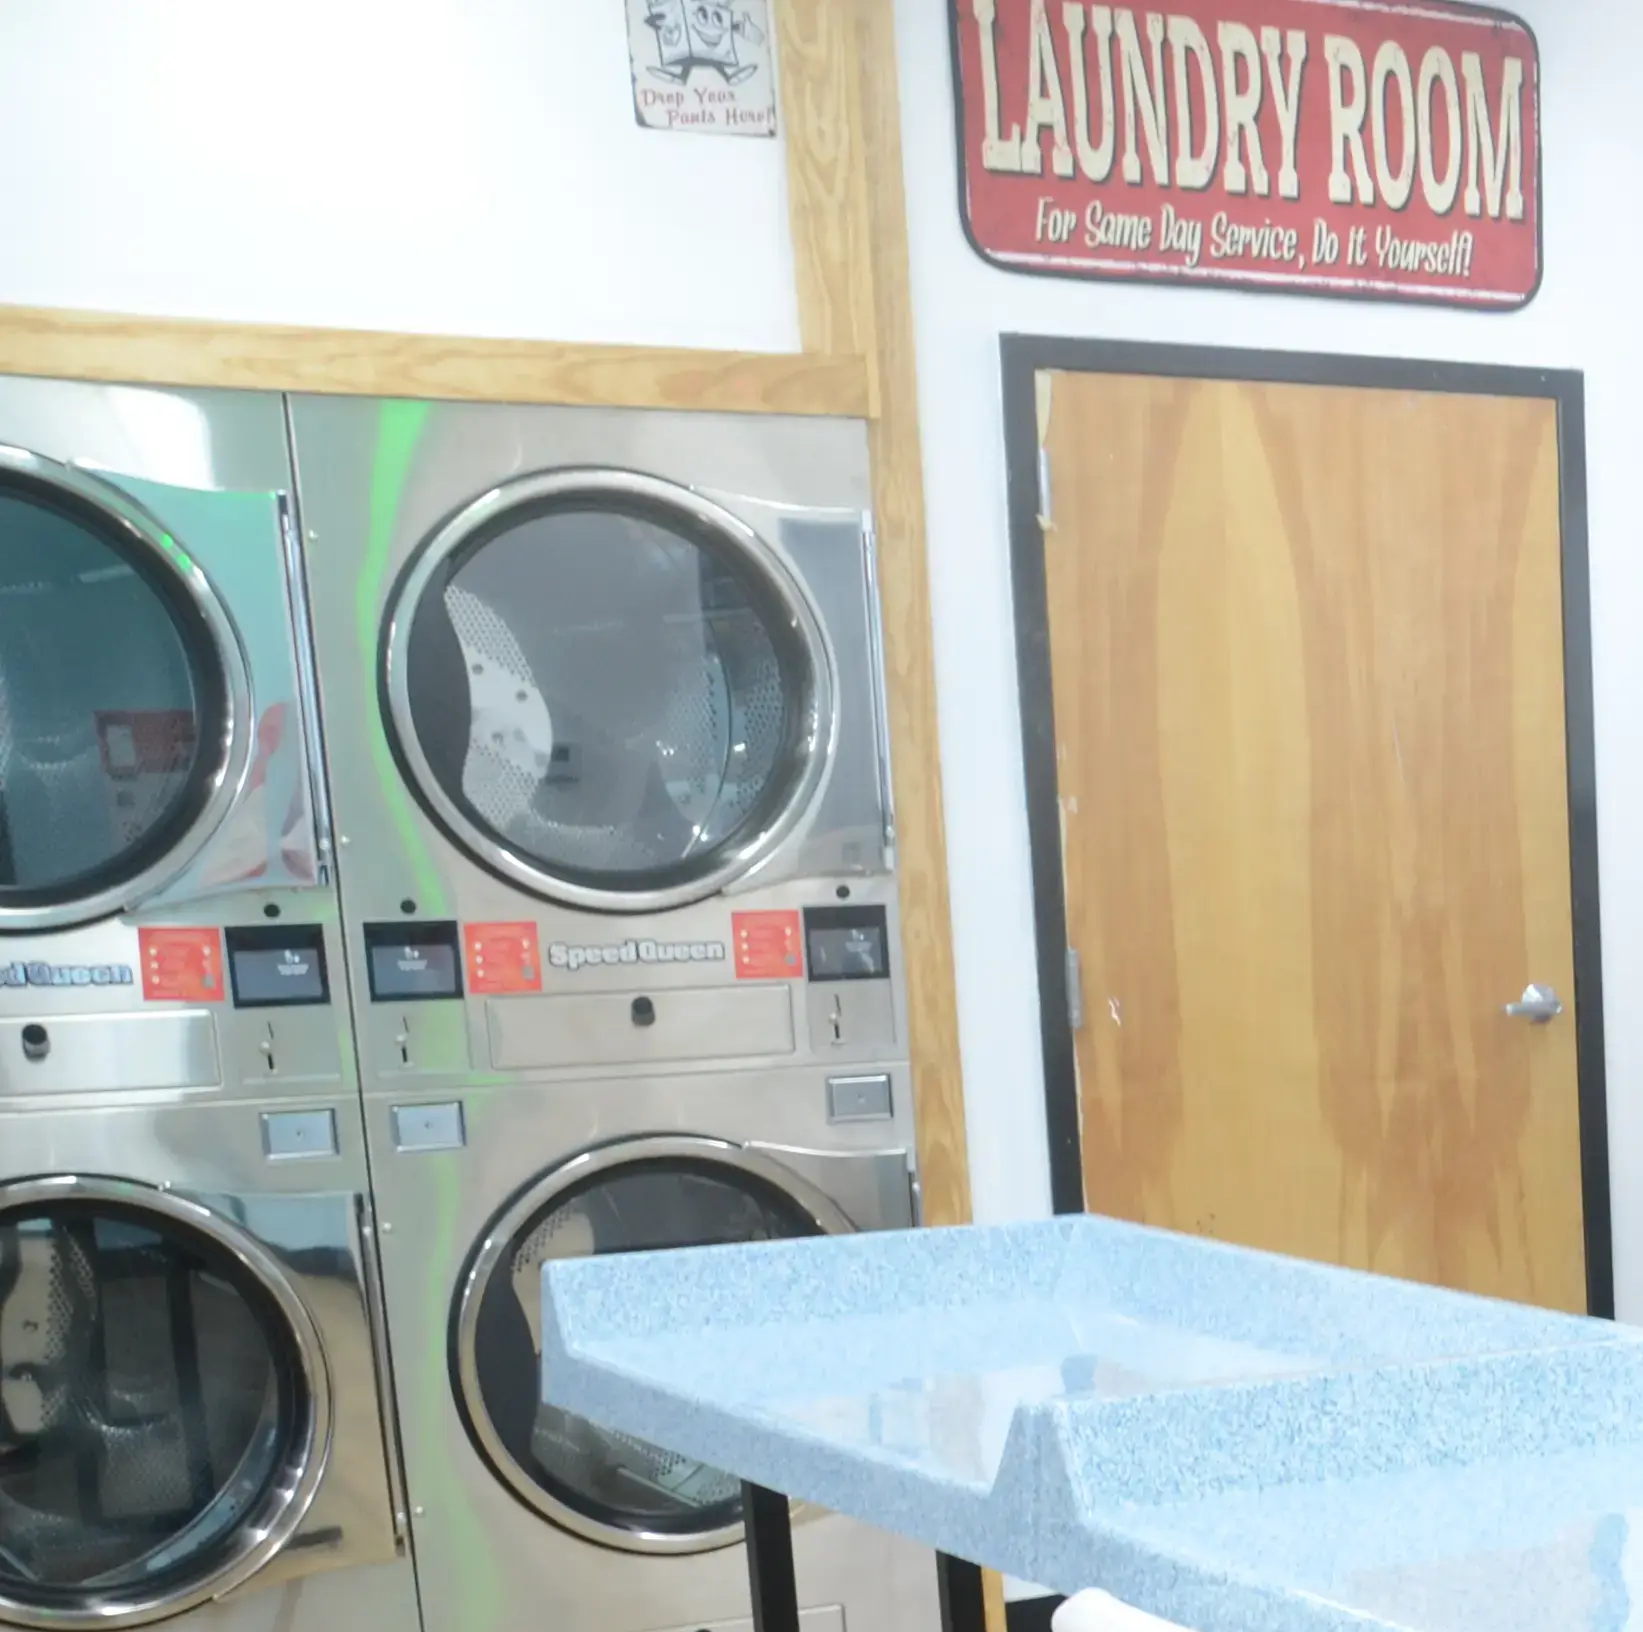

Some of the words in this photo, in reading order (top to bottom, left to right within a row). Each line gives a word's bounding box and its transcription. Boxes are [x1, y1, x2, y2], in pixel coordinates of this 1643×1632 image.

[974, 0, 1306, 199] LAUNDRY
[1324, 35, 1524, 220] ROOM
[1035, 196, 1077, 242] For
[1084, 199, 1152, 251] Same
[1159, 202, 1202, 268] Day
[1210, 210, 1305, 271] Service,
[1311, 217, 1339, 266] Do
[1375, 223, 1474, 277] Yourself!
[549, 938, 638, 971] Speed
[638, 938, 726, 964] Queen
